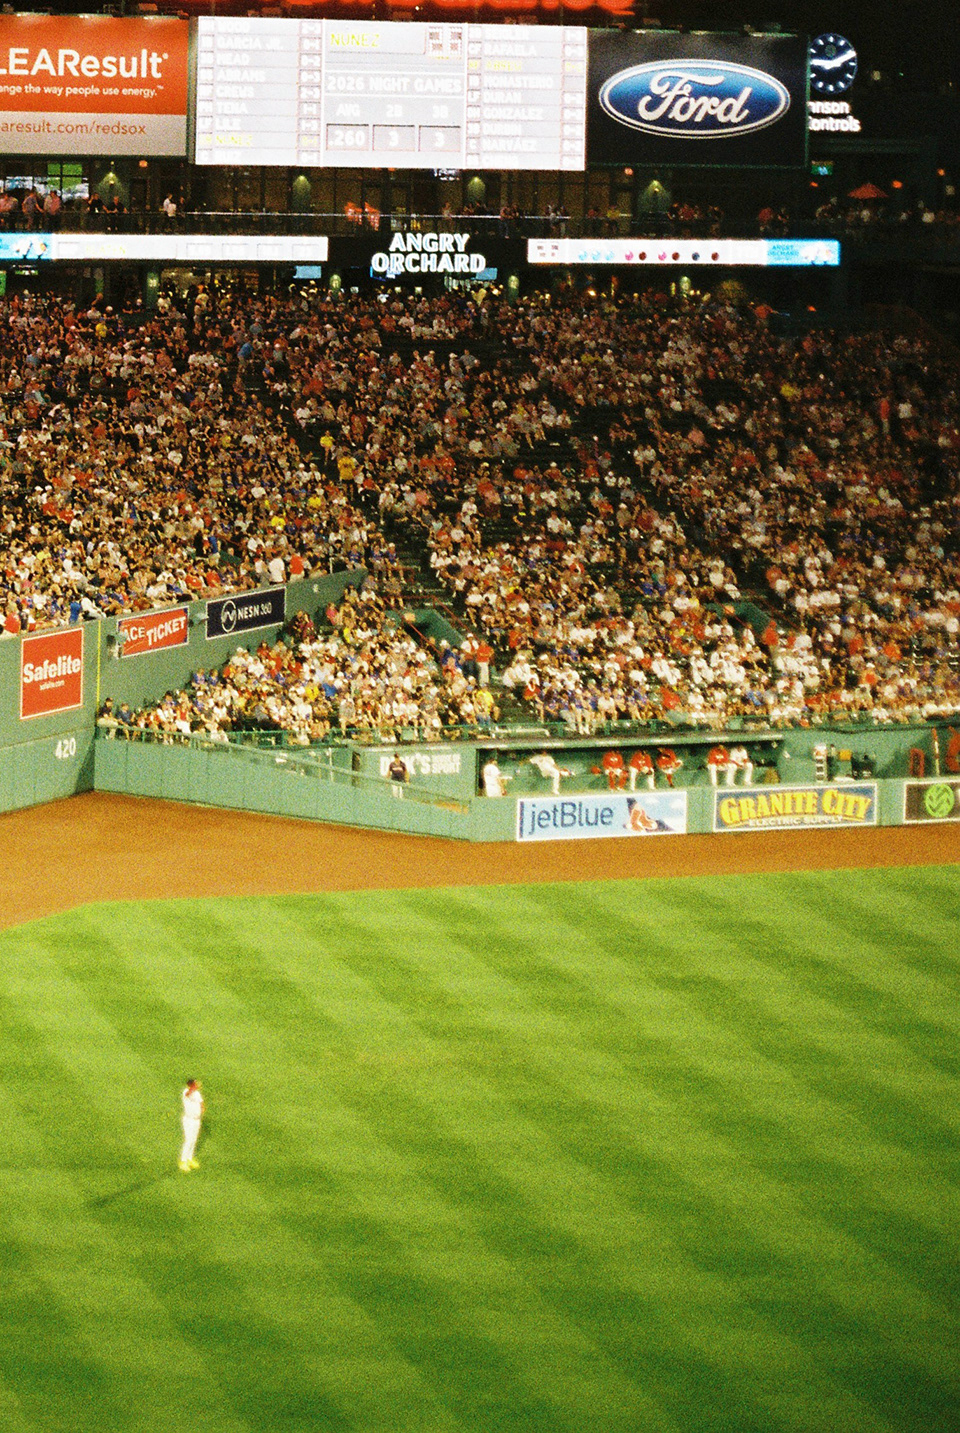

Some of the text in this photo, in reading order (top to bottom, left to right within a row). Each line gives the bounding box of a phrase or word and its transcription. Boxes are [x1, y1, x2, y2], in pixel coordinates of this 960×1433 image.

[217, 36, 262, 49] GARCIA
[24, 83, 41, 94] the
[43, 85, 64, 97] way
[65, 83, 100, 97] people
[102, 86, 120, 96] use
[327, 75, 365, 91] 2026
[369, 76, 411, 92] NIGHT
[413, 77, 462, 93] GAMES
[638, 70, 752, 123] Ford
[385, 104, 403, 118] 2B
[808, 115, 862, 132] ontrols
[328, 129, 366, 146] .260
[388, 130, 400, 147] 3
[434, 131, 446, 148] 3
[388, 232, 470, 253] ANGRY
[370, 252, 487, 273] ORCHARD
[237, 601, 273, 620] NESN 360
[146, 616, 187, 647] TICKET
[23, 654, 82, 684] Safelite
[54, 737, 77, 760] 420
[720, 789, 872, 825] GRANITE CITY
[529, 802, 614, 836] jetBlue
[748, 814, 845, 827] ELECTRIC SUPPLY
